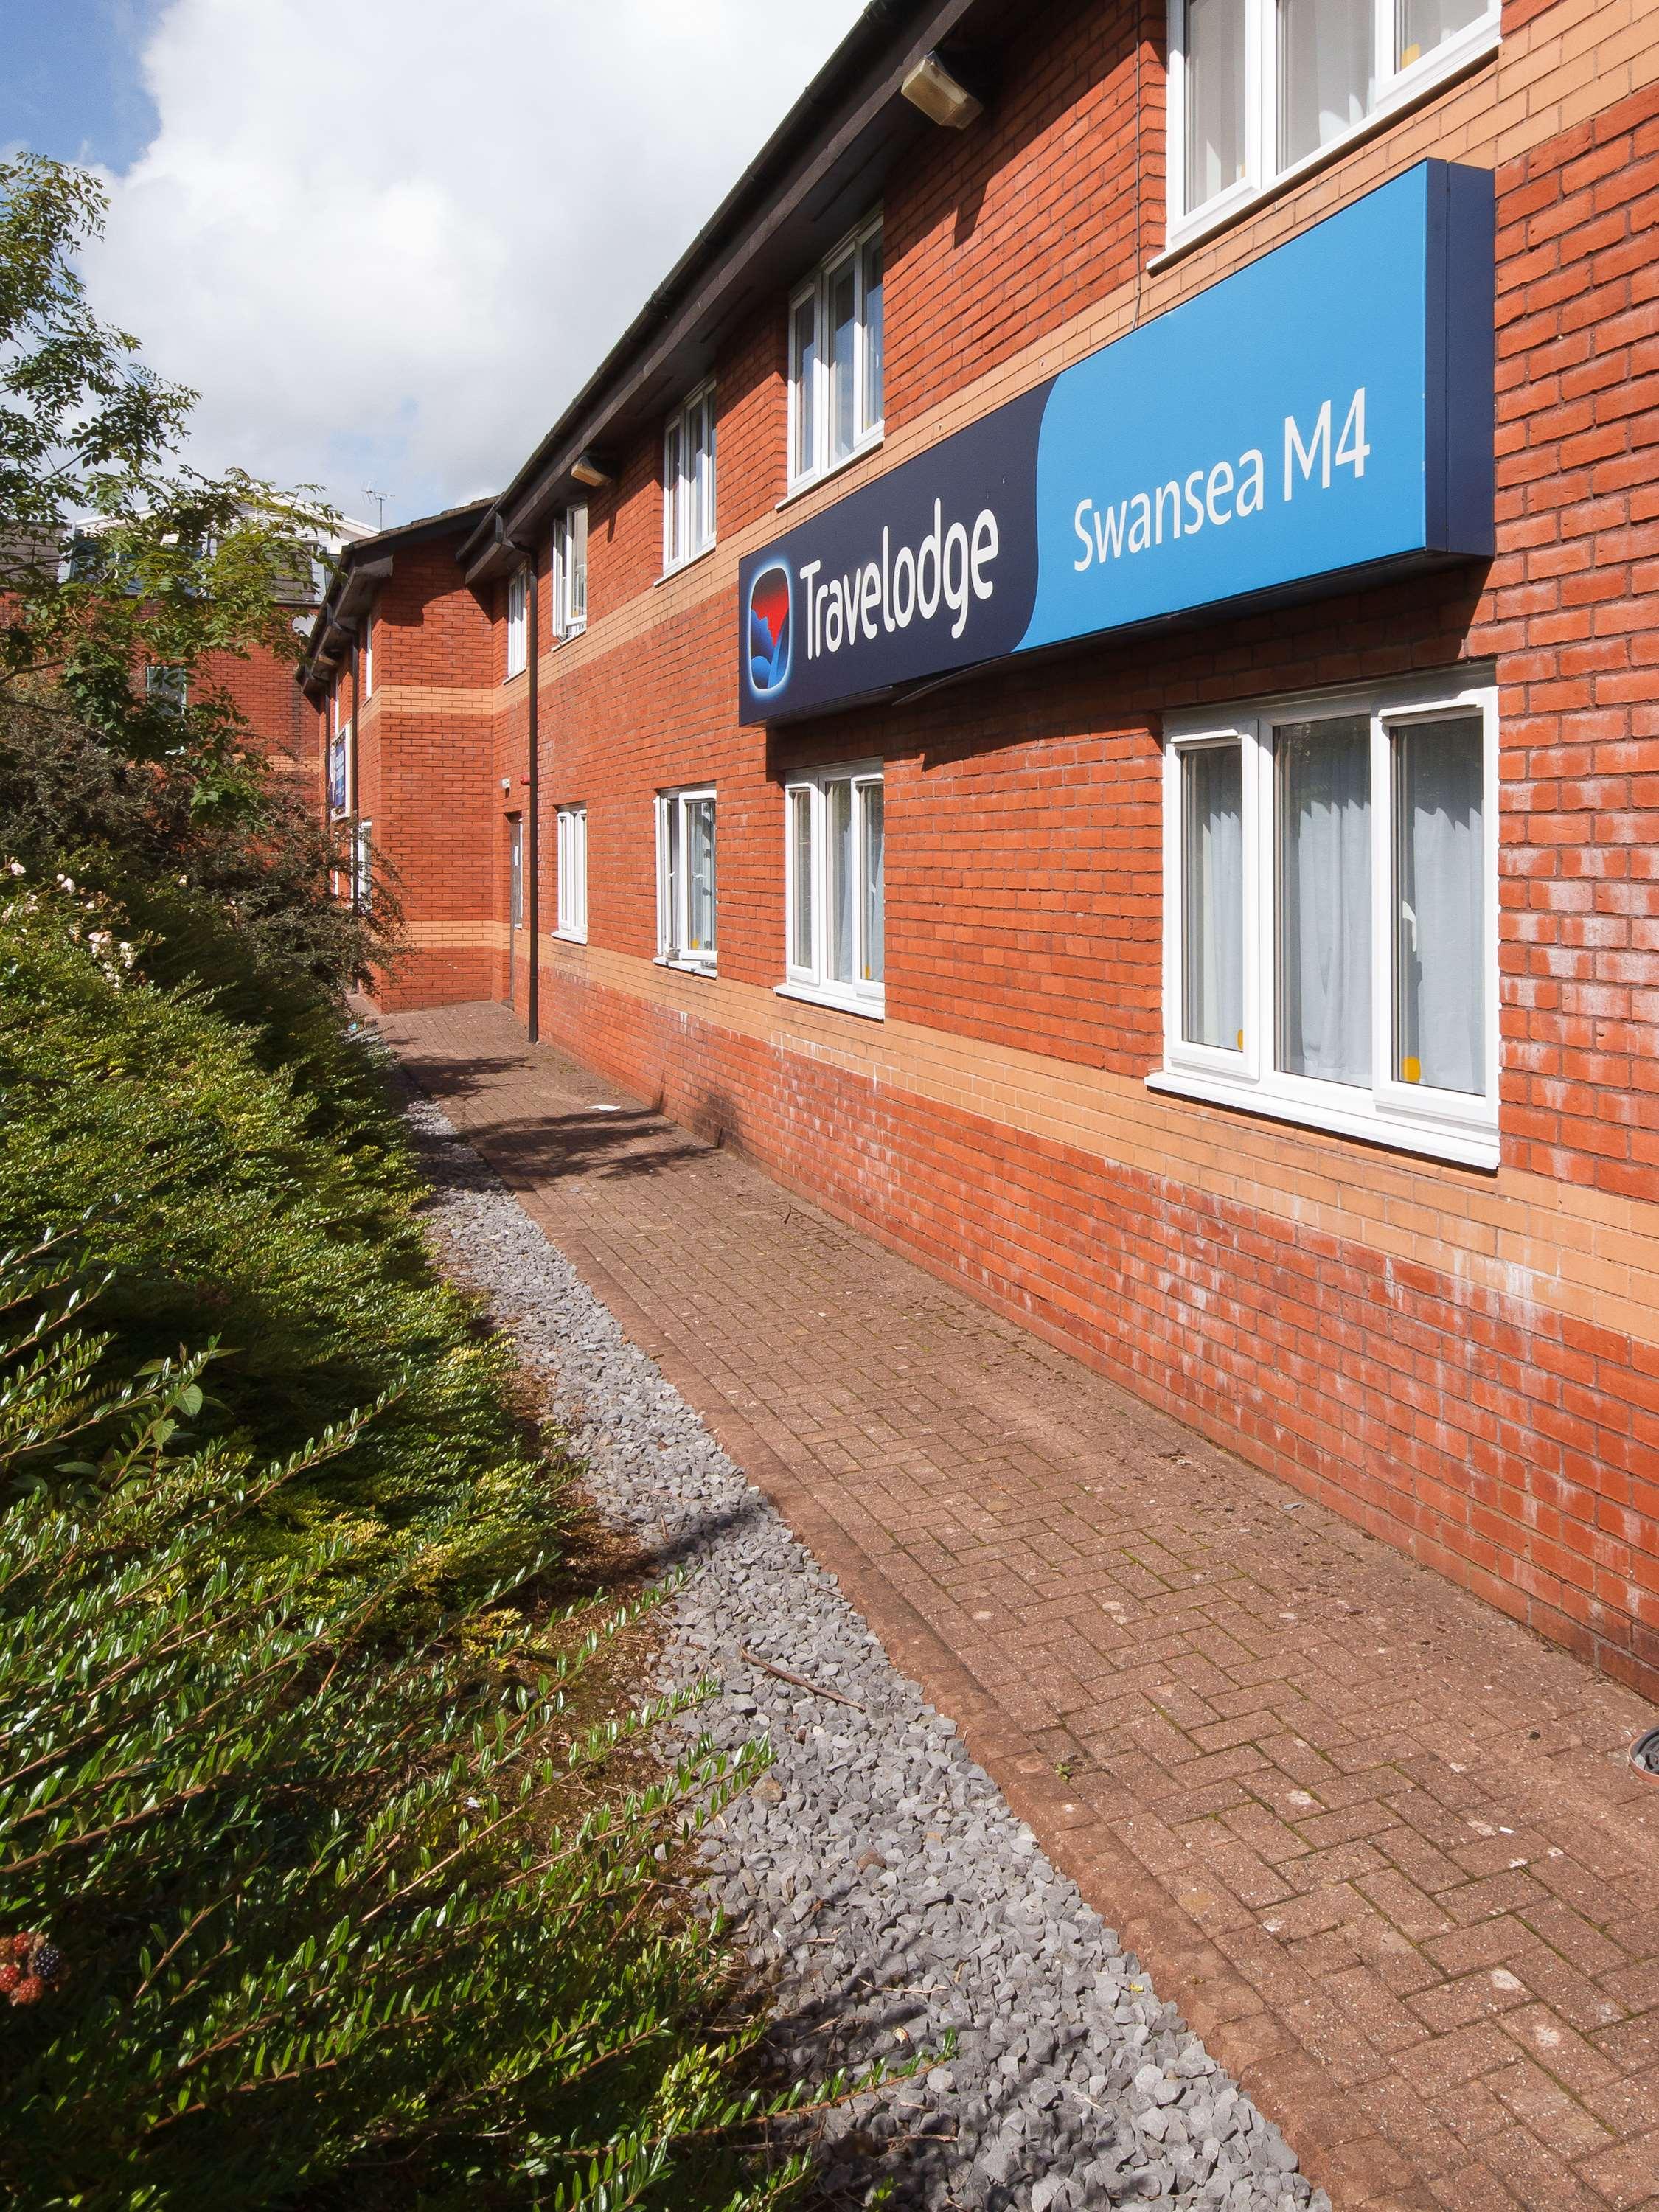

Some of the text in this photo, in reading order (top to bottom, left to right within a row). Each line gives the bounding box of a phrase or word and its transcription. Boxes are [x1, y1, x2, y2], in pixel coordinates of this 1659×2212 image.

[1074, 386, 1371, 571] Swansea M4
[800, 498, 998, 660] Travelodge
